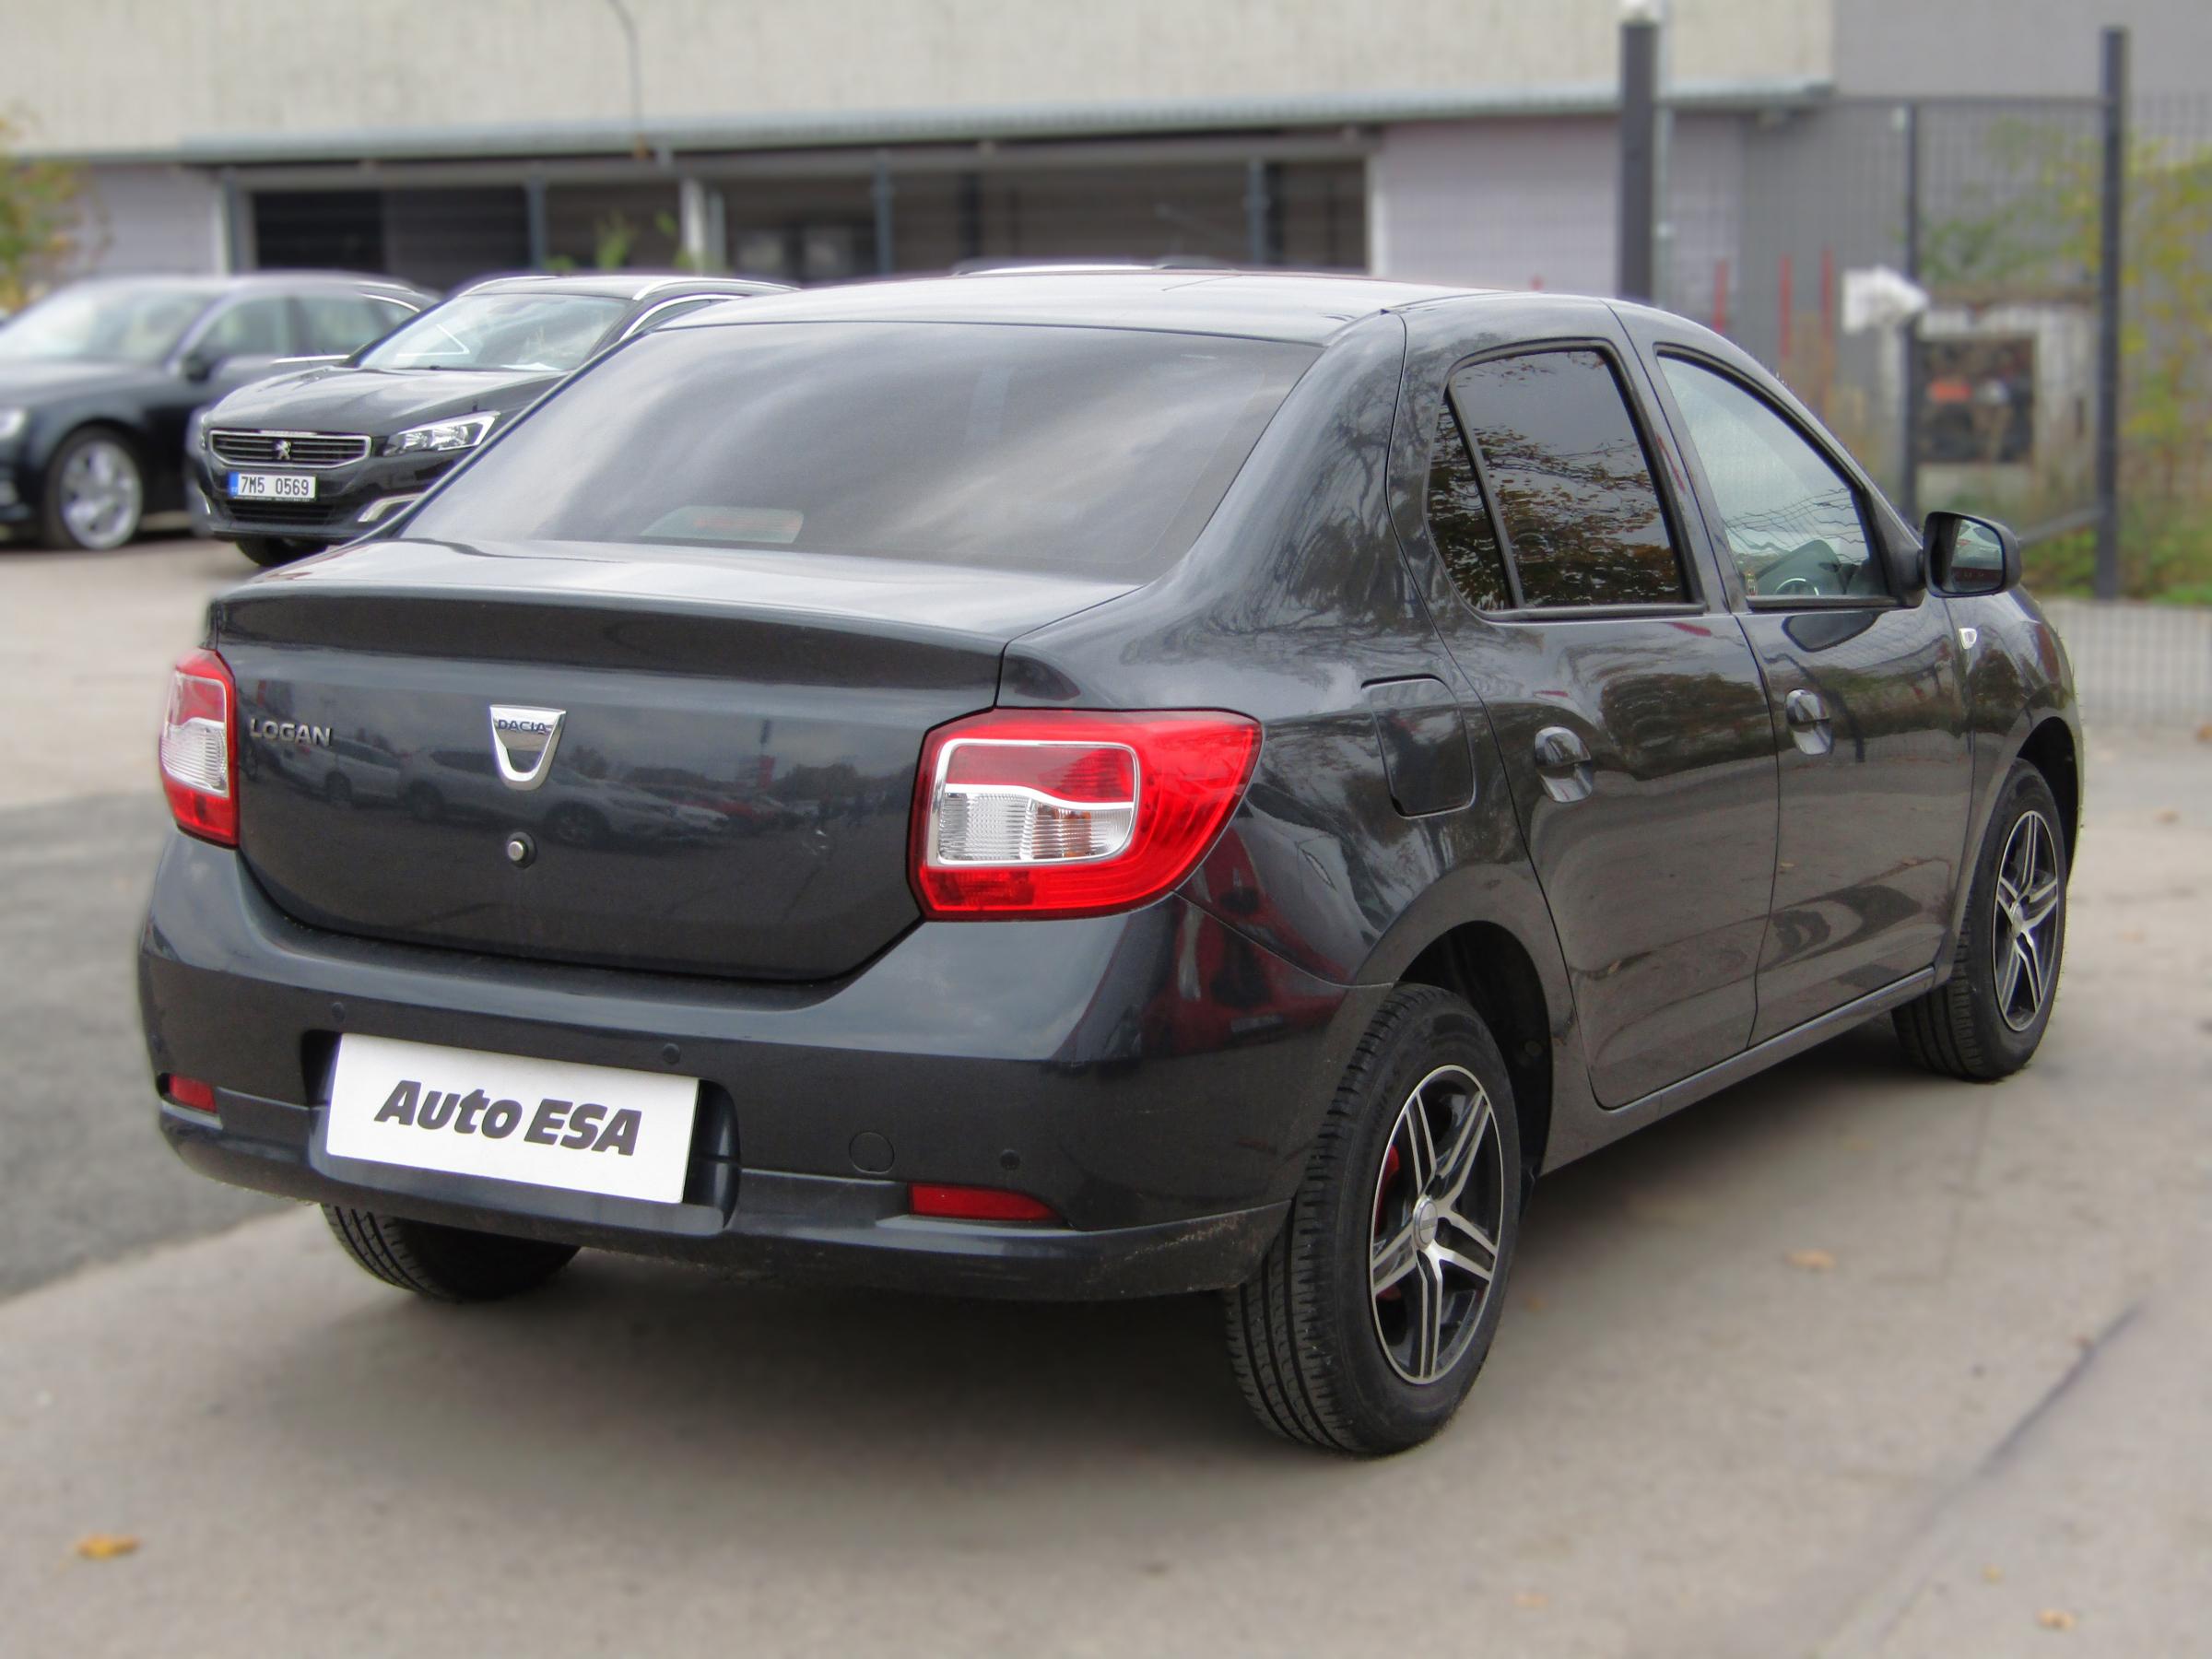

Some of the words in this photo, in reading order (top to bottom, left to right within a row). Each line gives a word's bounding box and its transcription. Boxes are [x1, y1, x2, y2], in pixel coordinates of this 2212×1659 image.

[241, 476, 265, 494] 7M5
[276, 477, 309, 496] 0569
[250, 718, 333, 747] LOGAN
[498, 719, 547, 733] DACIA
[374, 1079, 524, 1140] Auto
[524, 1099, 642, 1157] ESA
